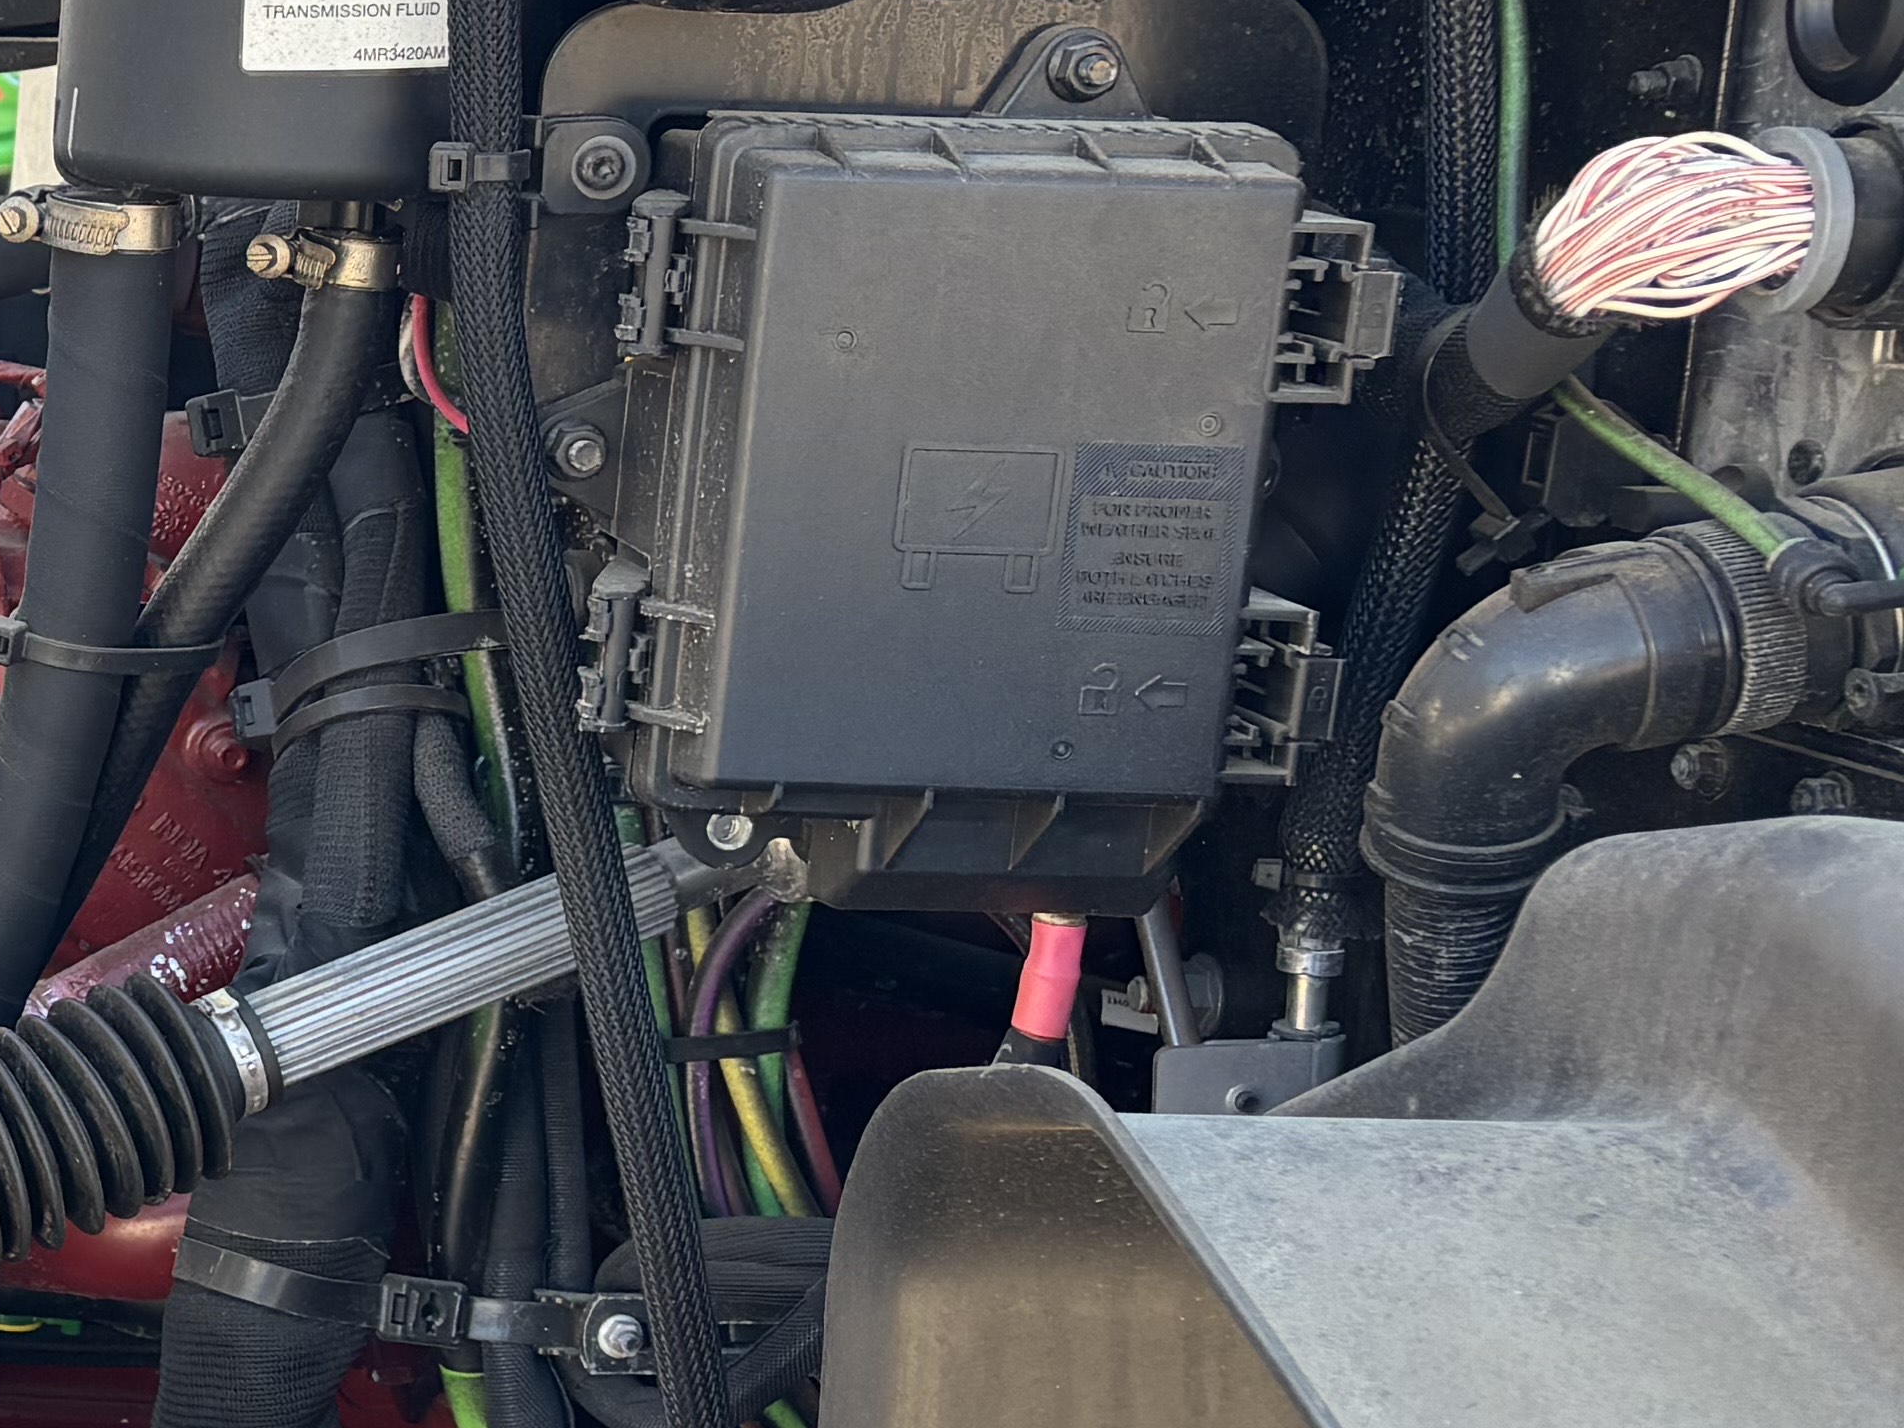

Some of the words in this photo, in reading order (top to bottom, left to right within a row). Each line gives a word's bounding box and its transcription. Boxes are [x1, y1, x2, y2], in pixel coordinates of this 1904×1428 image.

[263, 4, 391, 19] TRANSMISSION
[396, 2, 441, 16] FLUID
[1092, 501, 1131, 517] FOR
[1135, 503, 1213, 520] PROPER
